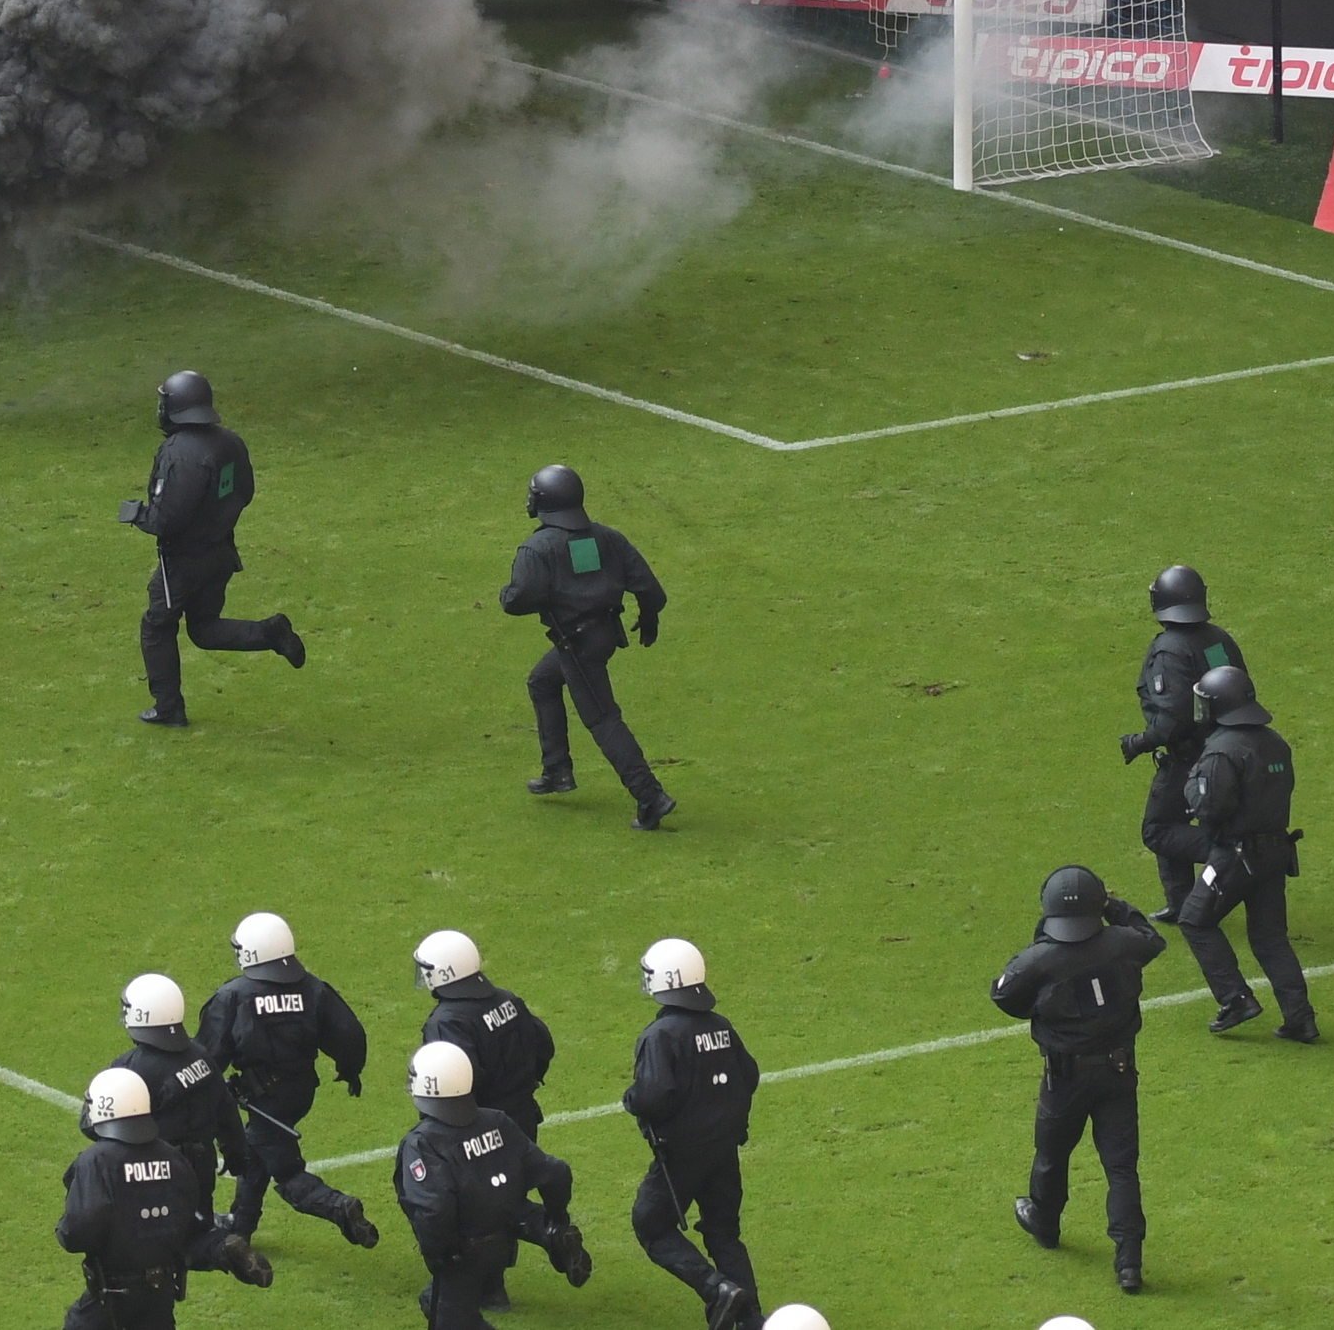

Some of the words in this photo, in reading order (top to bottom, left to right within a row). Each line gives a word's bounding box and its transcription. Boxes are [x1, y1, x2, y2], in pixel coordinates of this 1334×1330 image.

[1007, 35, 1171, 85] tipico
[244, 949, 259, 963] 31
[438, 965, 456, 982] 31
[665, 968, 682, 986] 31
[255, 994, 304, 1015] POLIZEI
[135, 1008, 151, 1024] 31
[482, 1000, 518, 1032] POLIZEI
[695, 1030, 731, 1053] POLIZEI
[176, 1058, 212, 1089] POLIZEI
[424, 1075, 438, 1090] 31
[97, 1095, 114, 1111] 32
[463, 1128, 505, 1161] POLIZEI
[124, 1161, 171, 1183] POLIZEI
